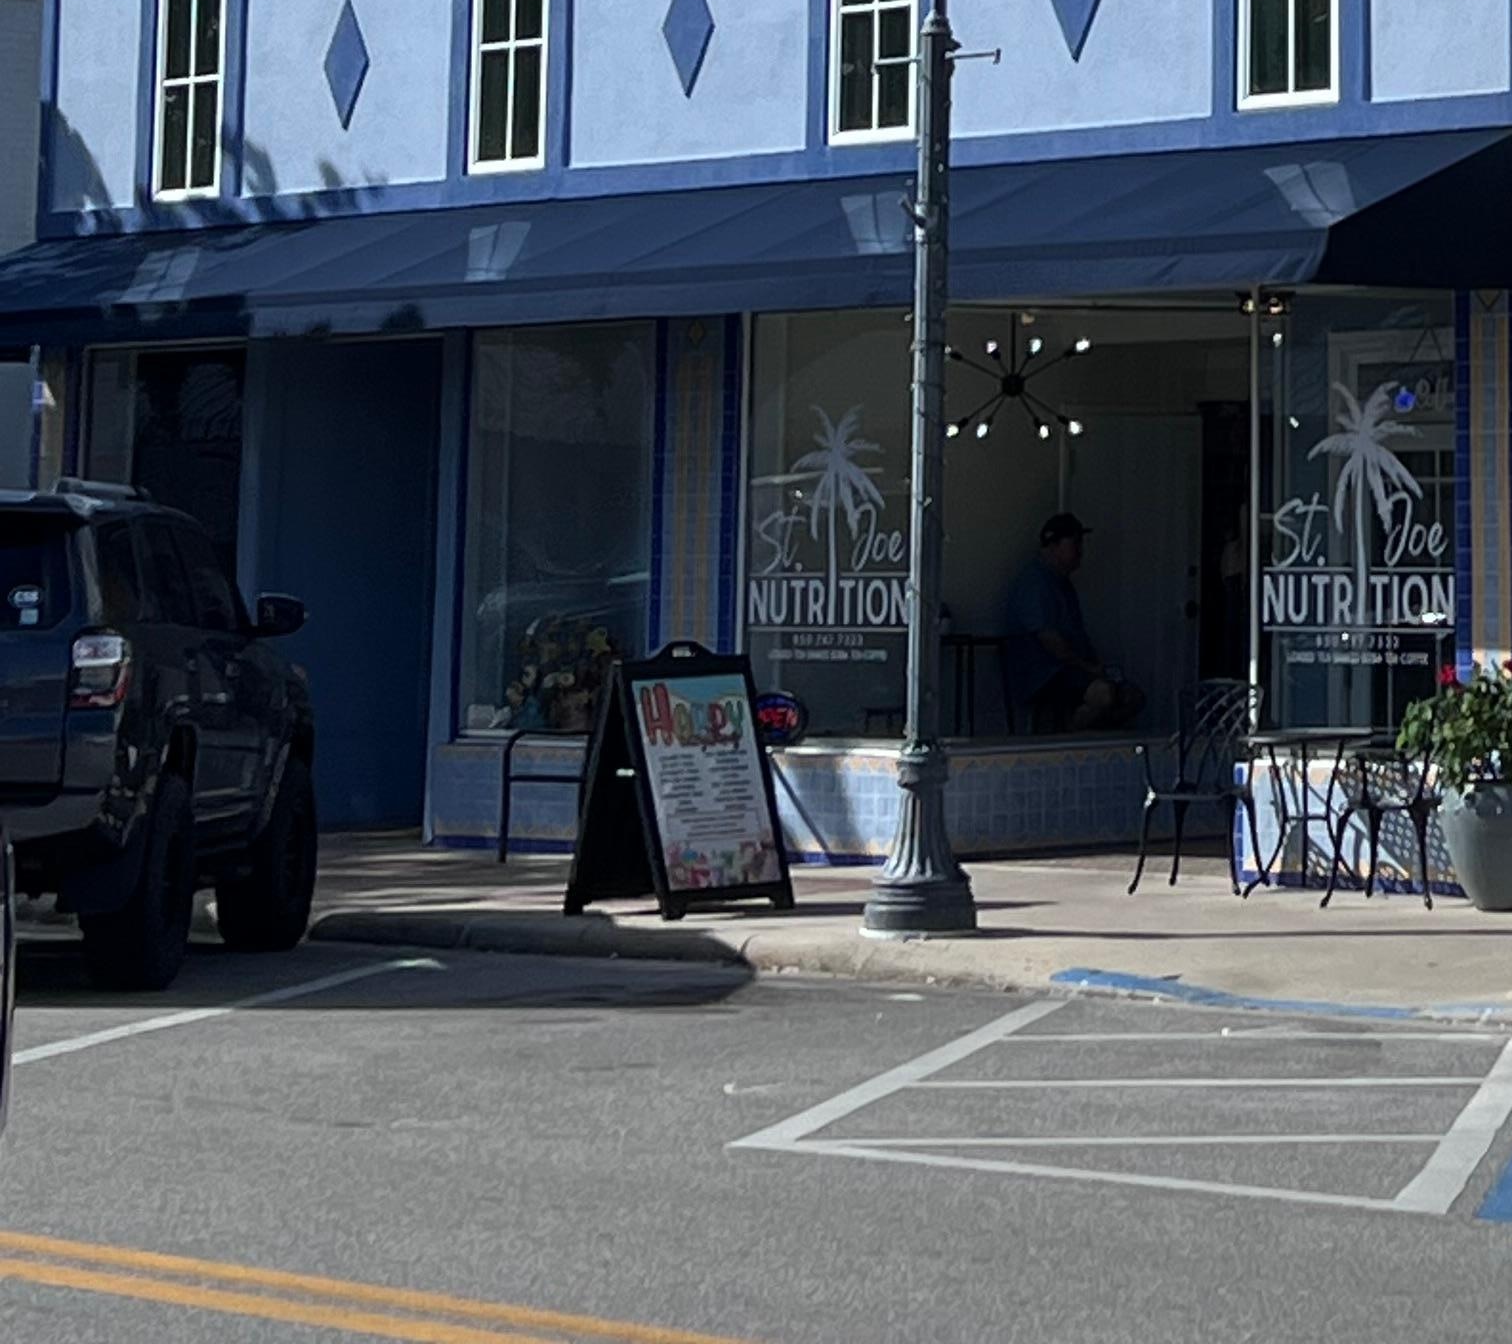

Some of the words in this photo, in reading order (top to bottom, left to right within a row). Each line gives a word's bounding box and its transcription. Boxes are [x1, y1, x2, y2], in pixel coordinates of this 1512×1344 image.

[754, 505, 808, 574] St.
[851, 501, 905, 572] Joe
[1271, 491, 1330, 568] St.
[1384, 491, 1450, 567] Joe
[1262, 573, 1456, 626] NUTRITION
